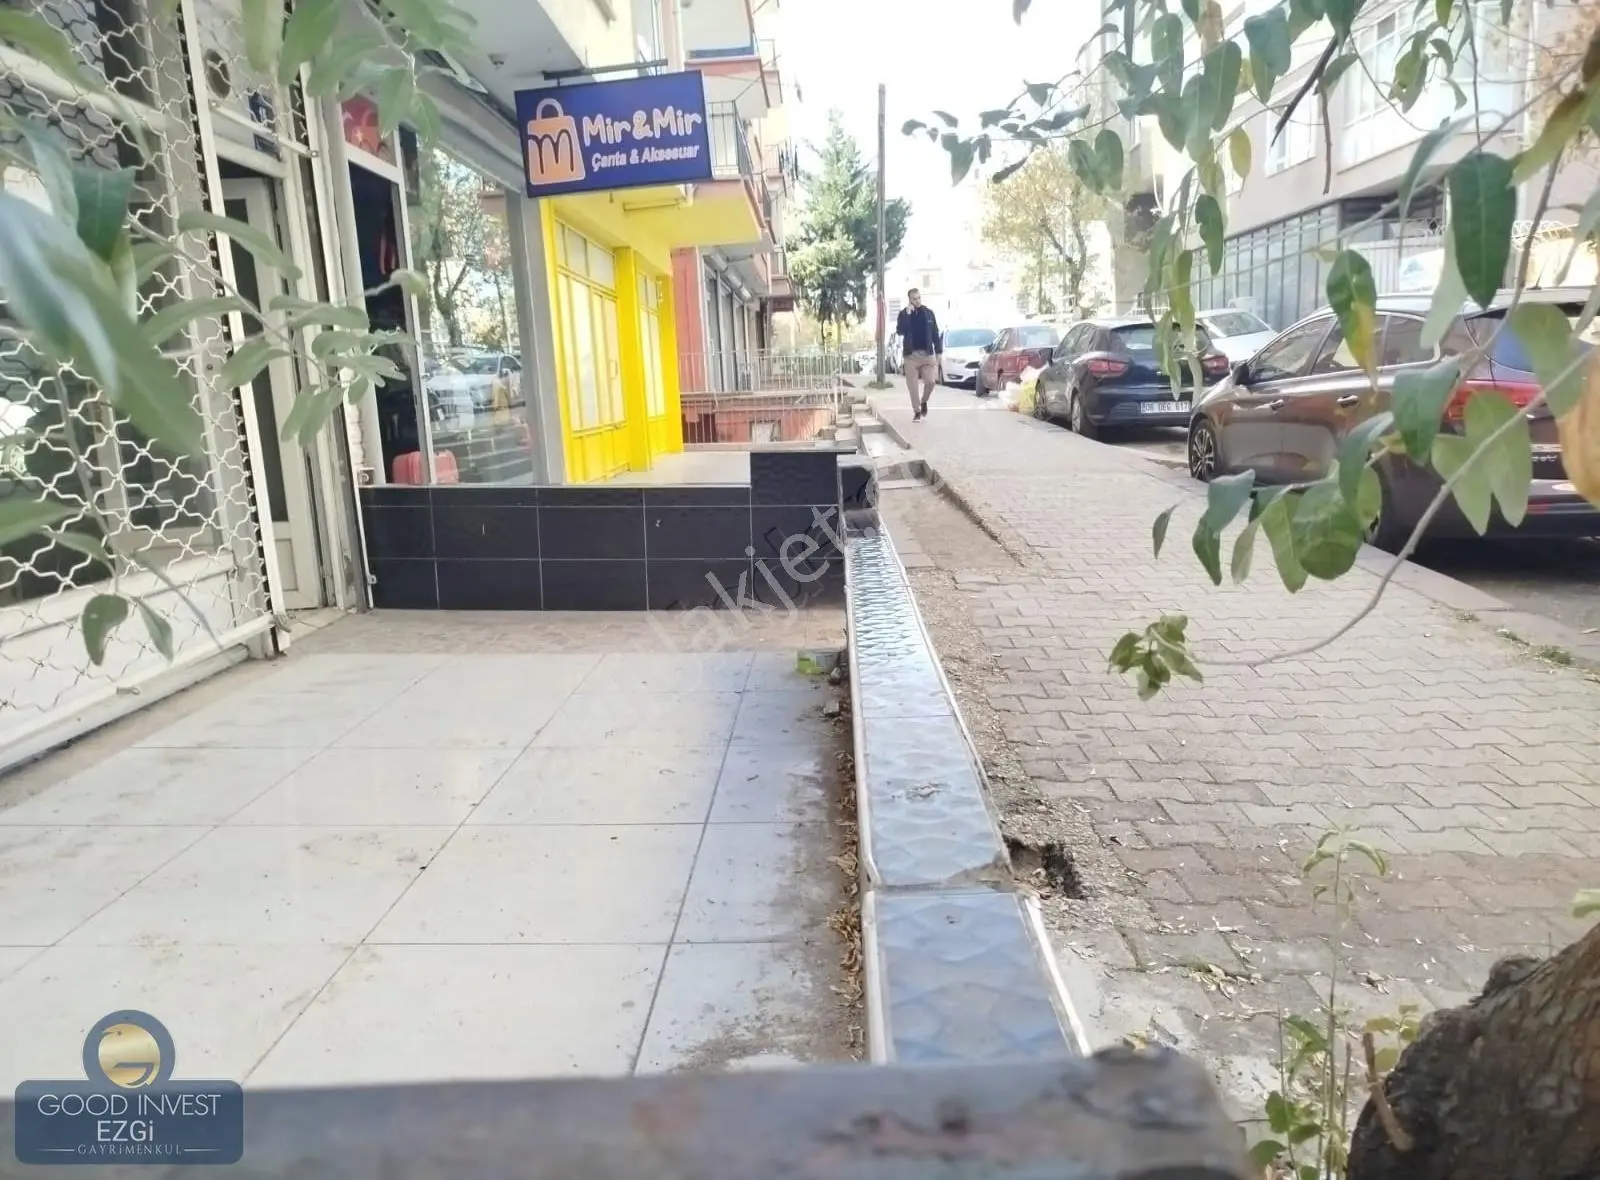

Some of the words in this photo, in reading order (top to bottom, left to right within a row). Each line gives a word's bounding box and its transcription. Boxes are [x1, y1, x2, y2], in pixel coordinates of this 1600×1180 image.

[582, 105, 702, 147] Mir&Mir
[592, 151, 627, 172] Çanta
[629, 148, 640, 165] &
[640, 144, 700, 164] Aksesuar
